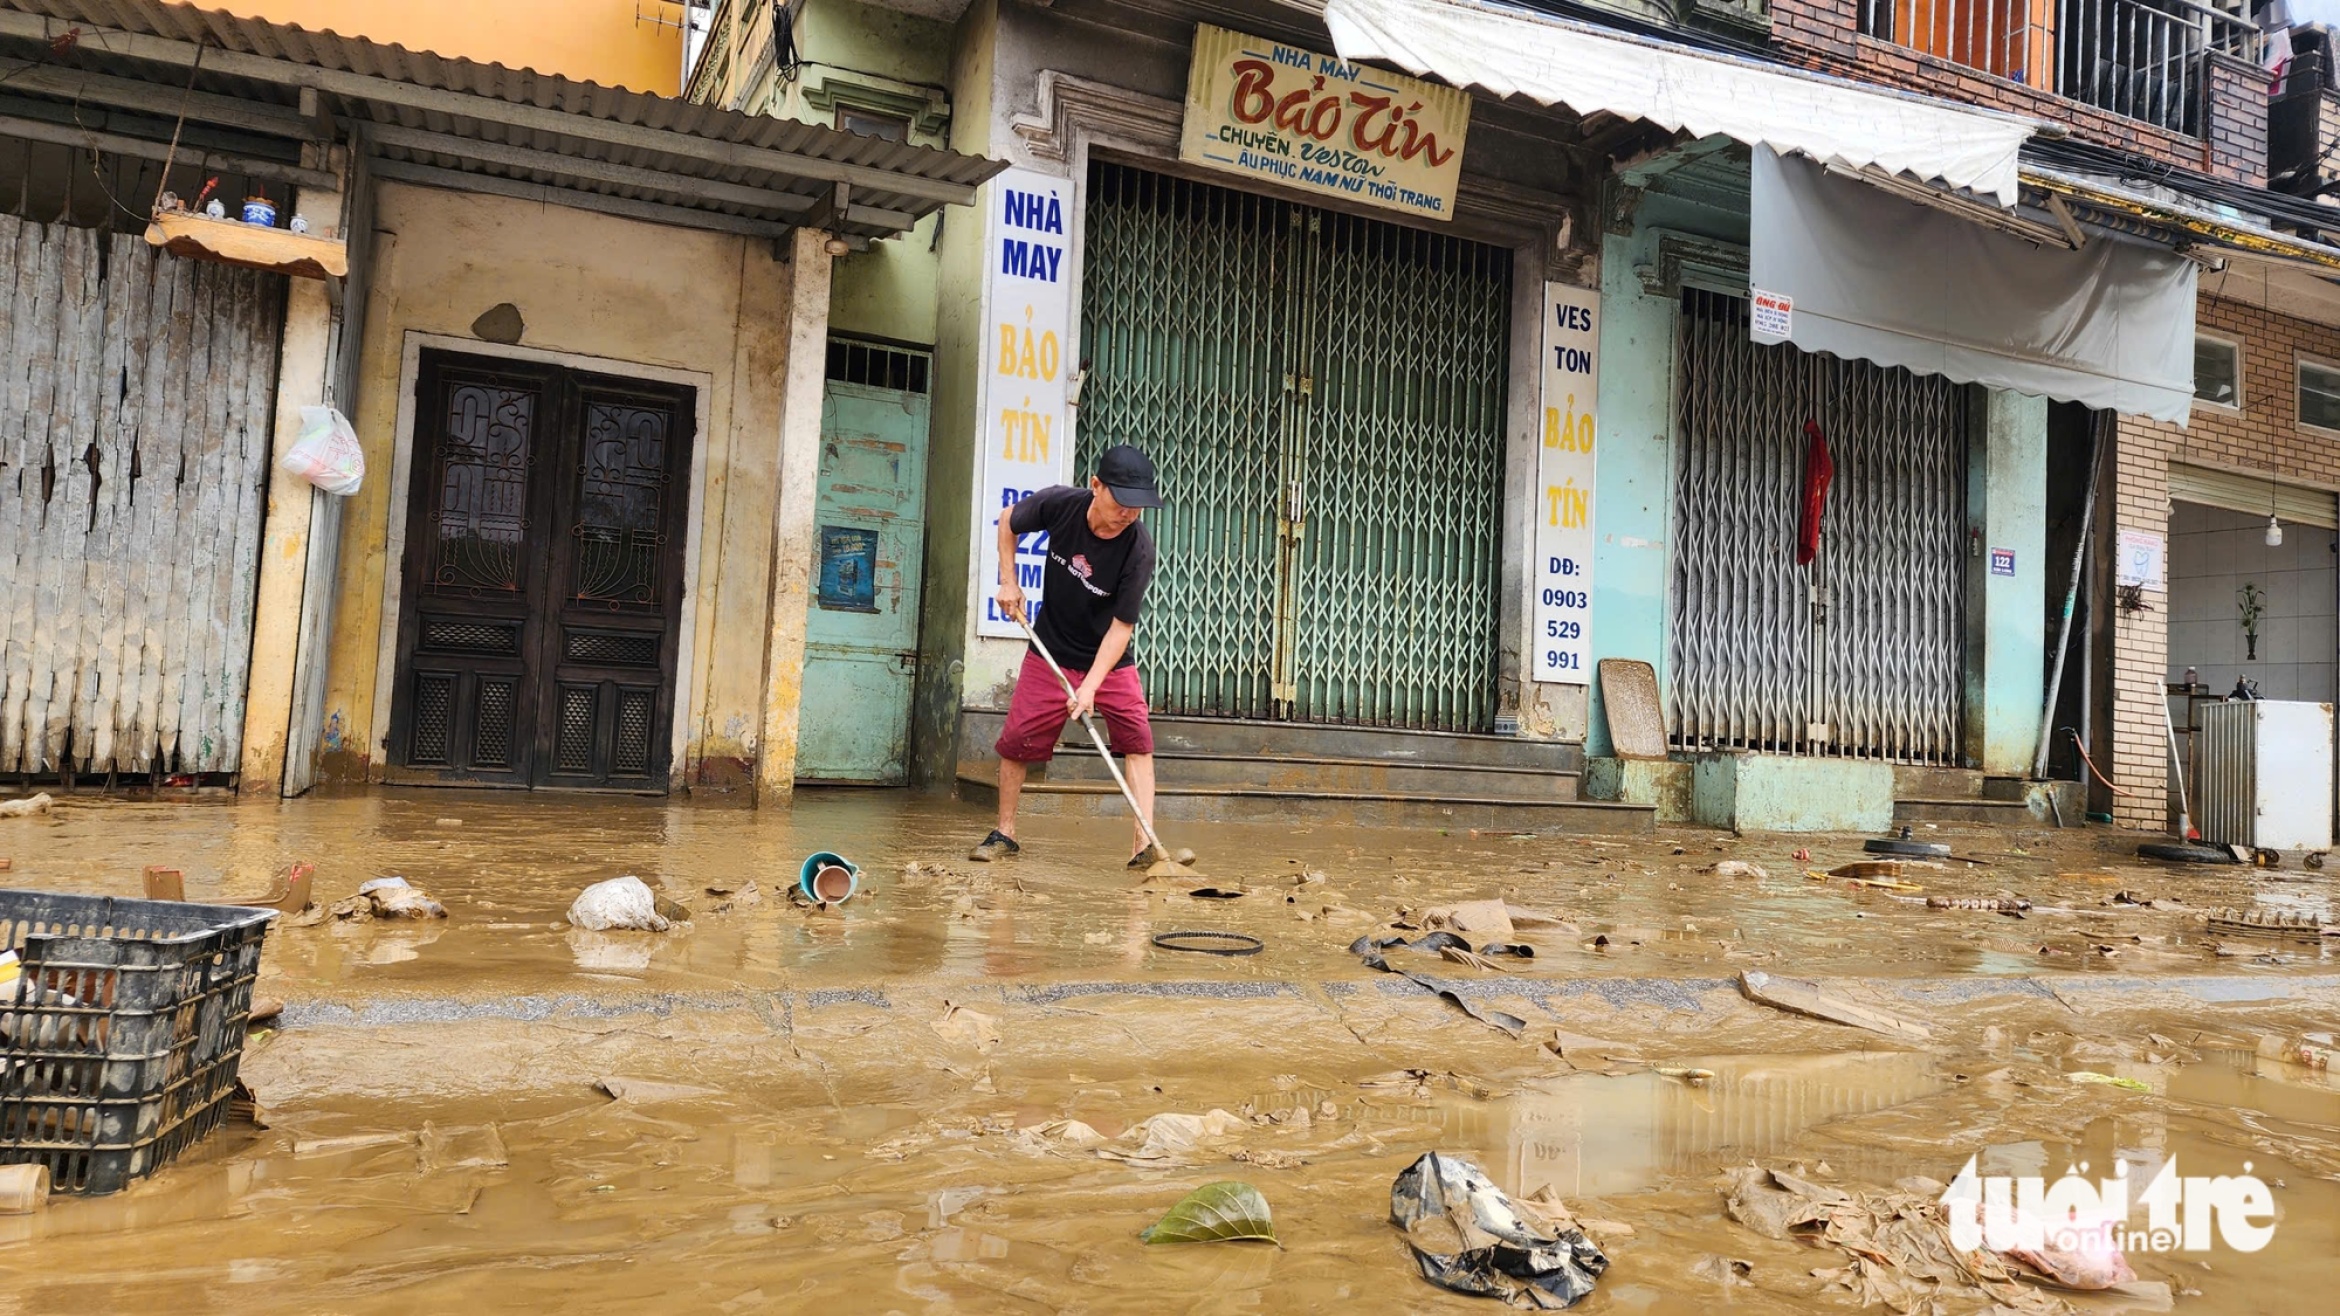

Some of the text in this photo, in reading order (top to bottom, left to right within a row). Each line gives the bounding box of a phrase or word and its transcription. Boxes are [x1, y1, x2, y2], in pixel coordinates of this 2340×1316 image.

[1319, 58, 1362, 82] MAY
[1232, 59, 1455, 168] Bảo Tín
[1238, 149, 1259, 171] ÂU
[1260, 160, 1297, 180] PHỤC
[1299, 166, 1337, 188] NAM
[1338, 174, 1367, 193] NỮ
[1004, 189, 1063, 235] NHÀ
[1002, 238, 1063, 283] MAY
[1555, 303, 1591, 332] VES
[997, 304, 1060, 383] BẢO
[1554, 345, 1591, 375] TON
[1000, 395, 1052, 465] TÍN
[1544, 393, 1594, 454] BẢO
[1547, 476, 1589, 529] TÍN
[1550, 557, 1580, 576] DĐ:
[1995, 556, 2010, 568] 122
[1542, 588, 1588, 609] 0903
[1547, 620, 1581, 639] 529
[1547, 650, 1580, 670] 991
